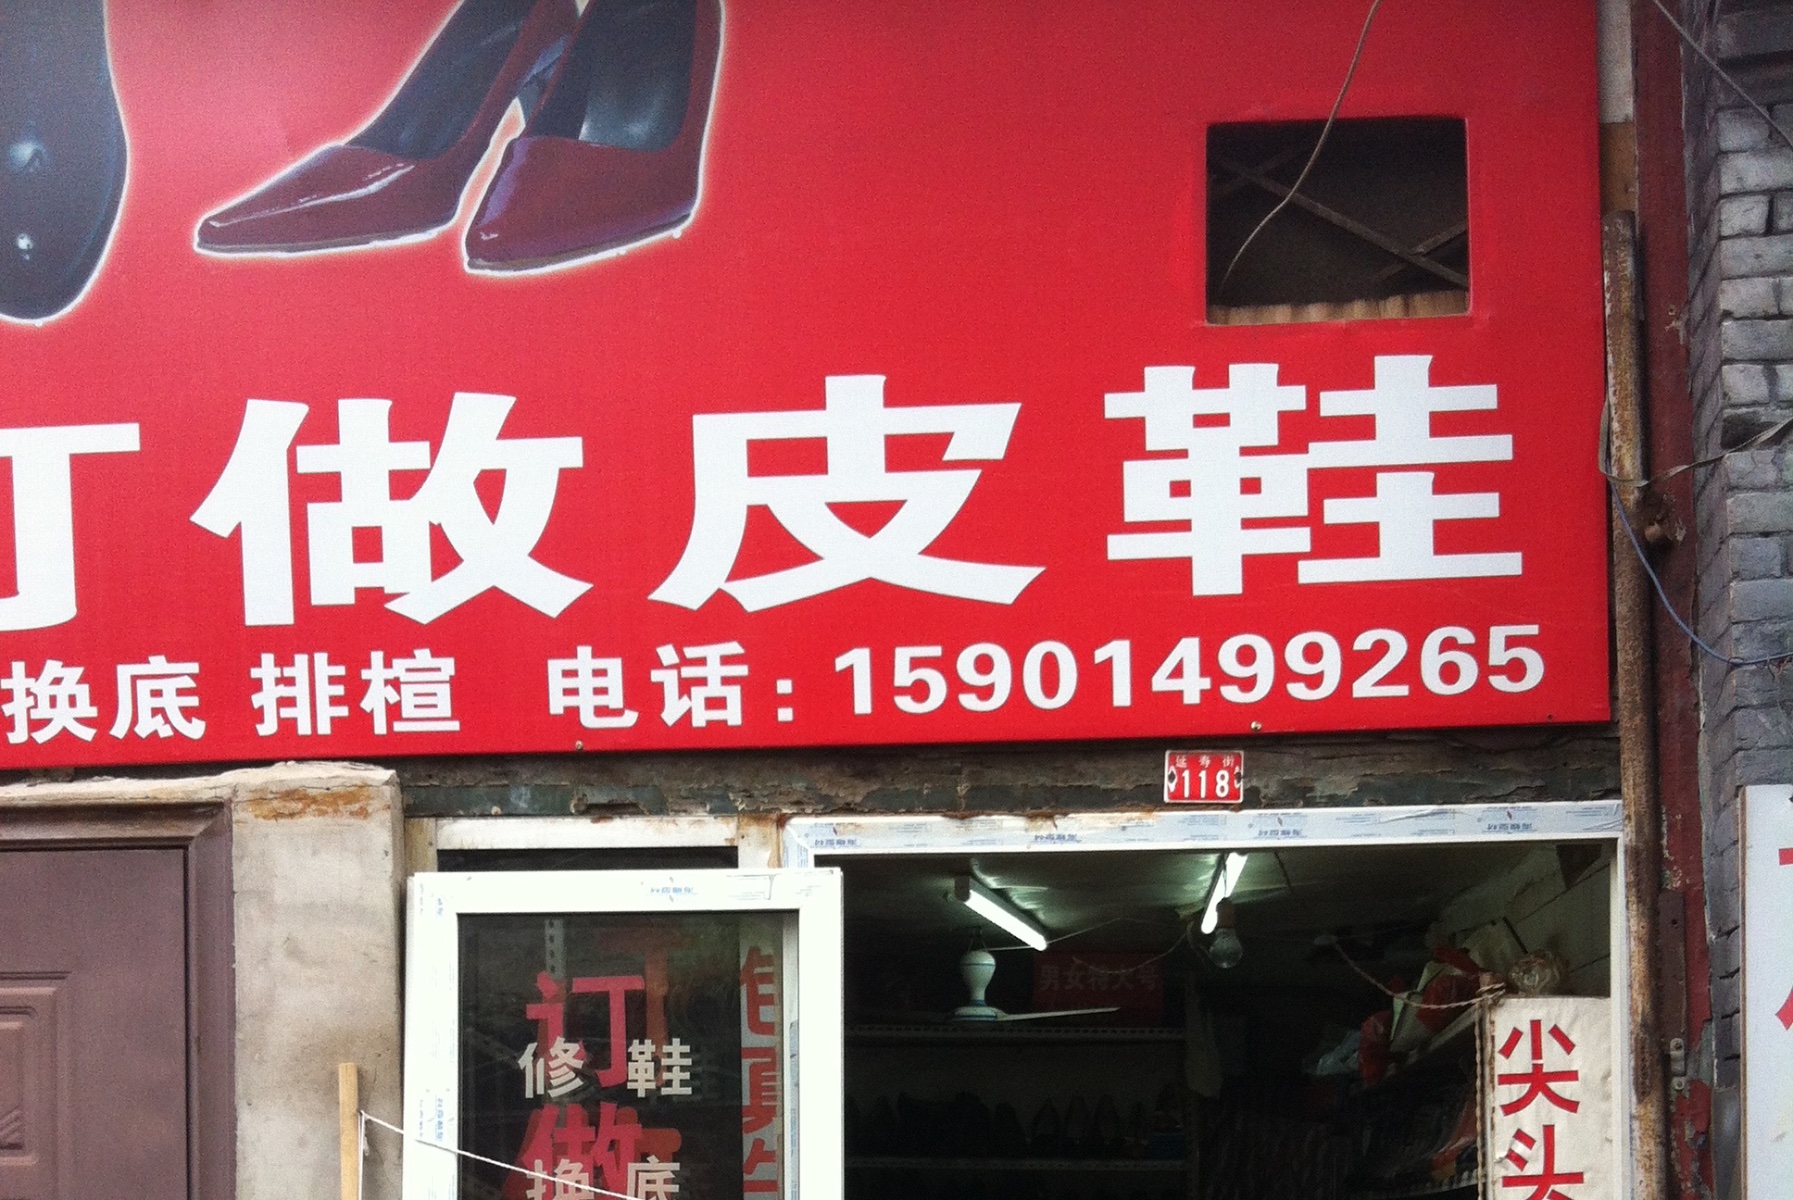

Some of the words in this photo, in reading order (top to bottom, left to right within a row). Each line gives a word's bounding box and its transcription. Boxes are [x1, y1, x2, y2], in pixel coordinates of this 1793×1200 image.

[1, 655, 205, 745] 换底
[250, 648, 460, 737] 排楦
[1182, 769, 1230, 799] 118
[518, 1036, 693, 1099] 修鞋
